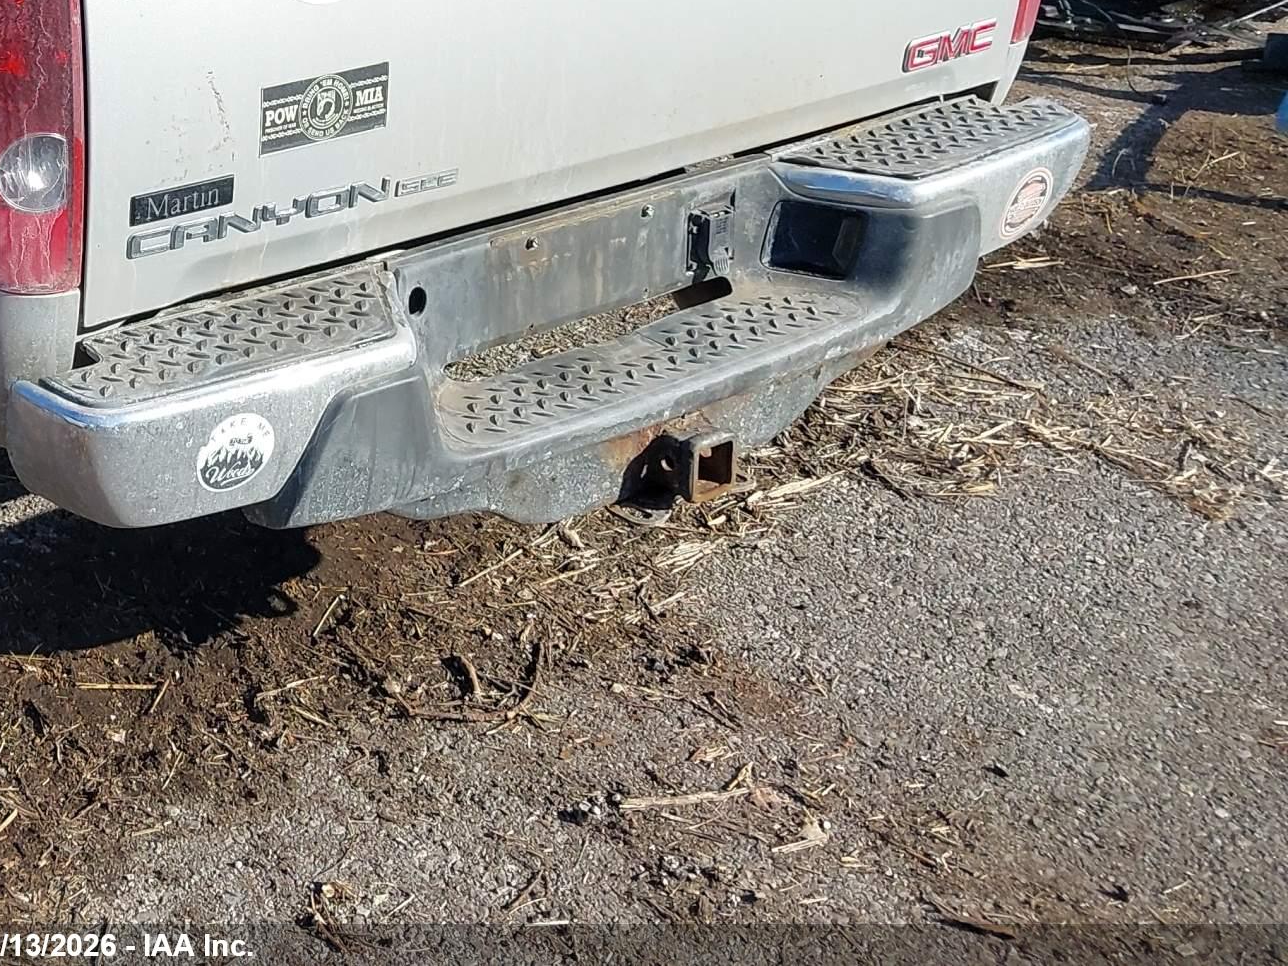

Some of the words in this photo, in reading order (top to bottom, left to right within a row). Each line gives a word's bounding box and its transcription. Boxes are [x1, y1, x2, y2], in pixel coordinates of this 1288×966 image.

[902, 17, 997, 73] GMC
[303, 85, 320, 109] BRING
[354, 86, 384, 107] MIA
[265, 104, 299, 127] POW
[307, 126, 325, 137] SEND
[325, 128, 335, 136] US
[334, 109, 349, 132] BACK
[146, 187, 220, 218] Martin
[126, 174, 391, 260] CANYON
[205, 460, 255, 485] Woods
